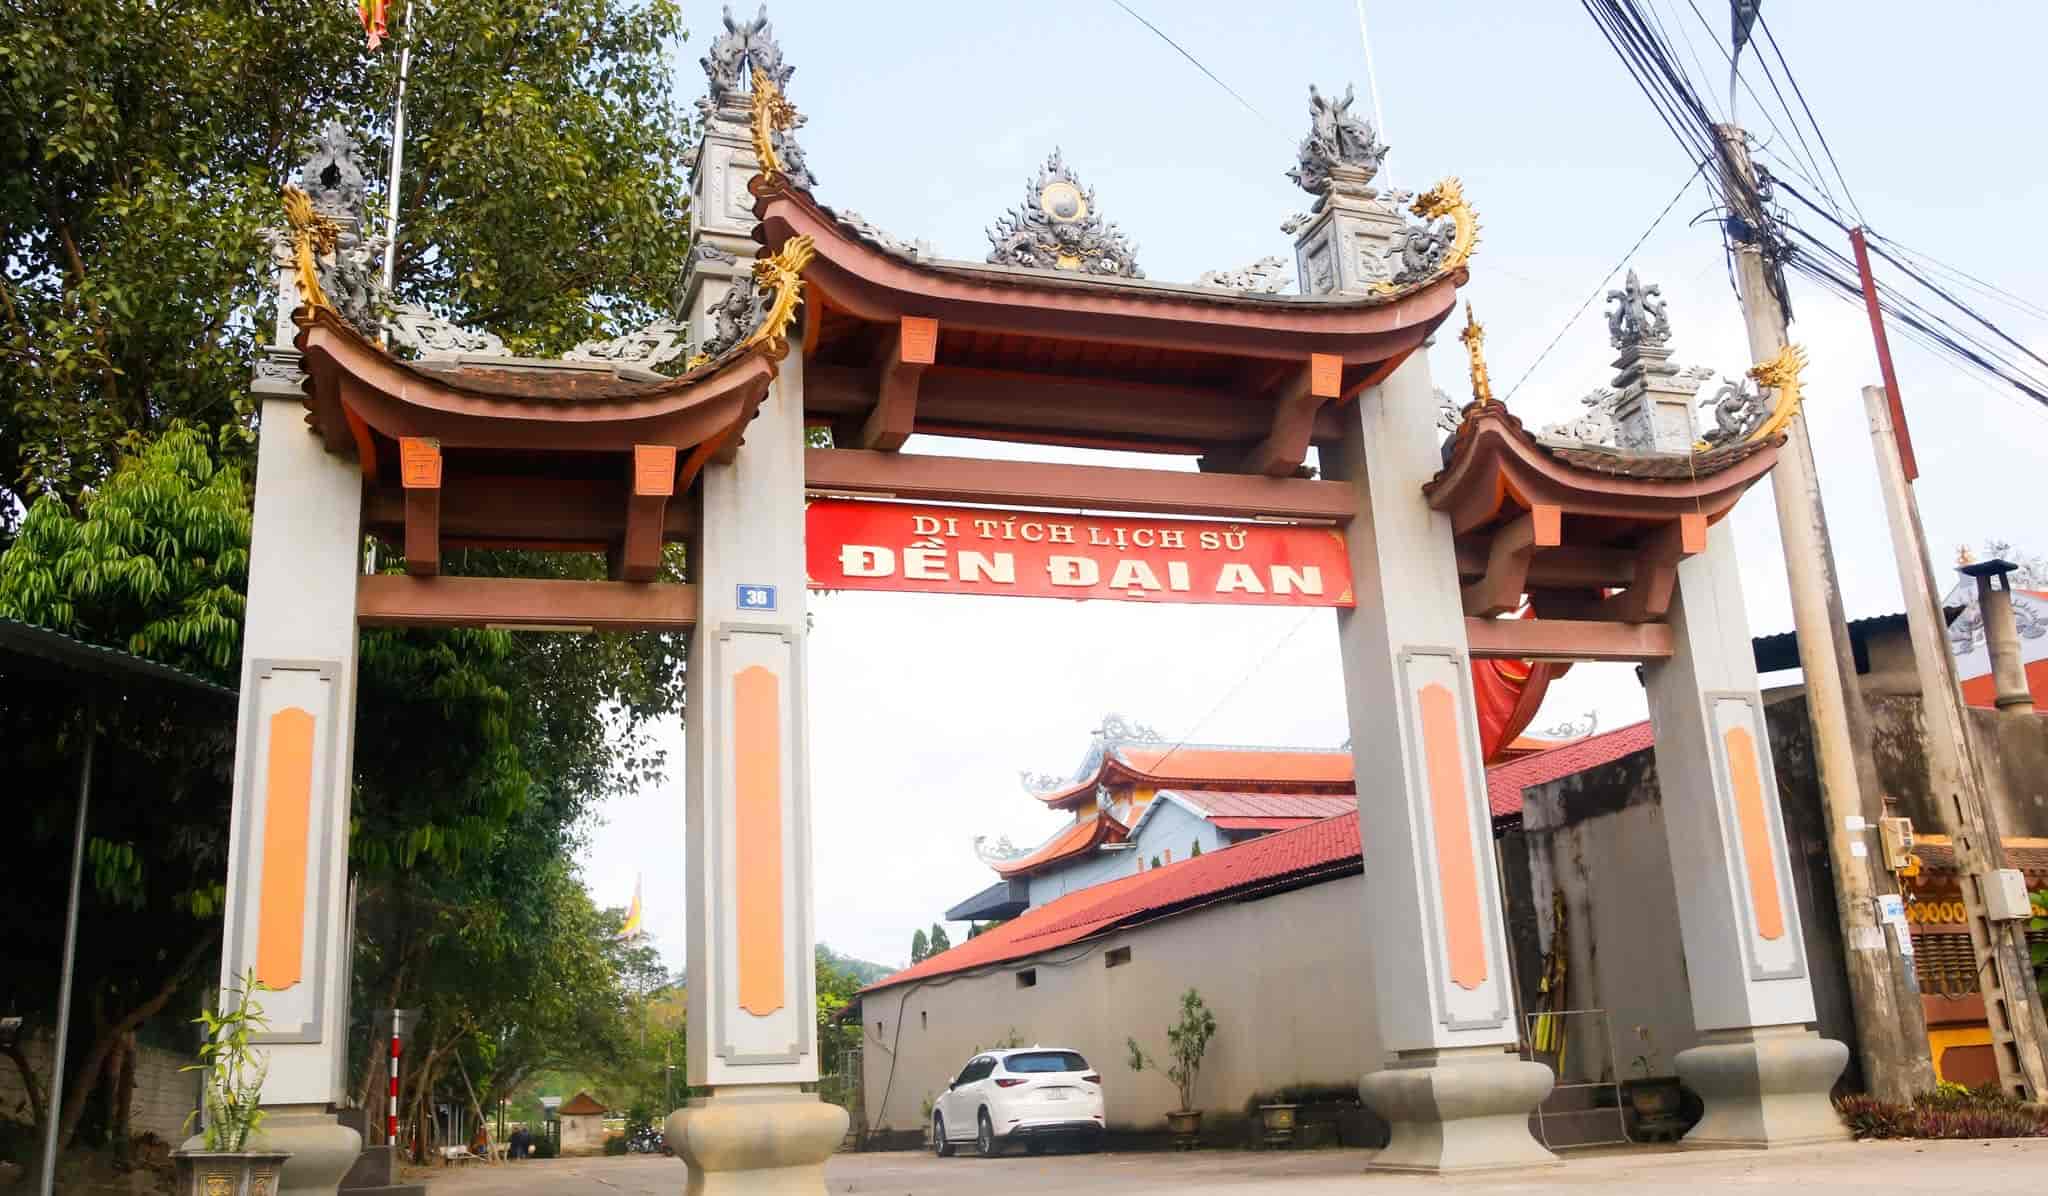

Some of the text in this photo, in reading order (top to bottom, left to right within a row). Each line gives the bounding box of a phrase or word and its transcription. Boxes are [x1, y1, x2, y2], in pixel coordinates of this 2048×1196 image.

[912, 515, 1249, 551] DI TÍCH LỊCH SỬ
[838, 536, 1323, 597] ĐỀN ĐẠI AN
